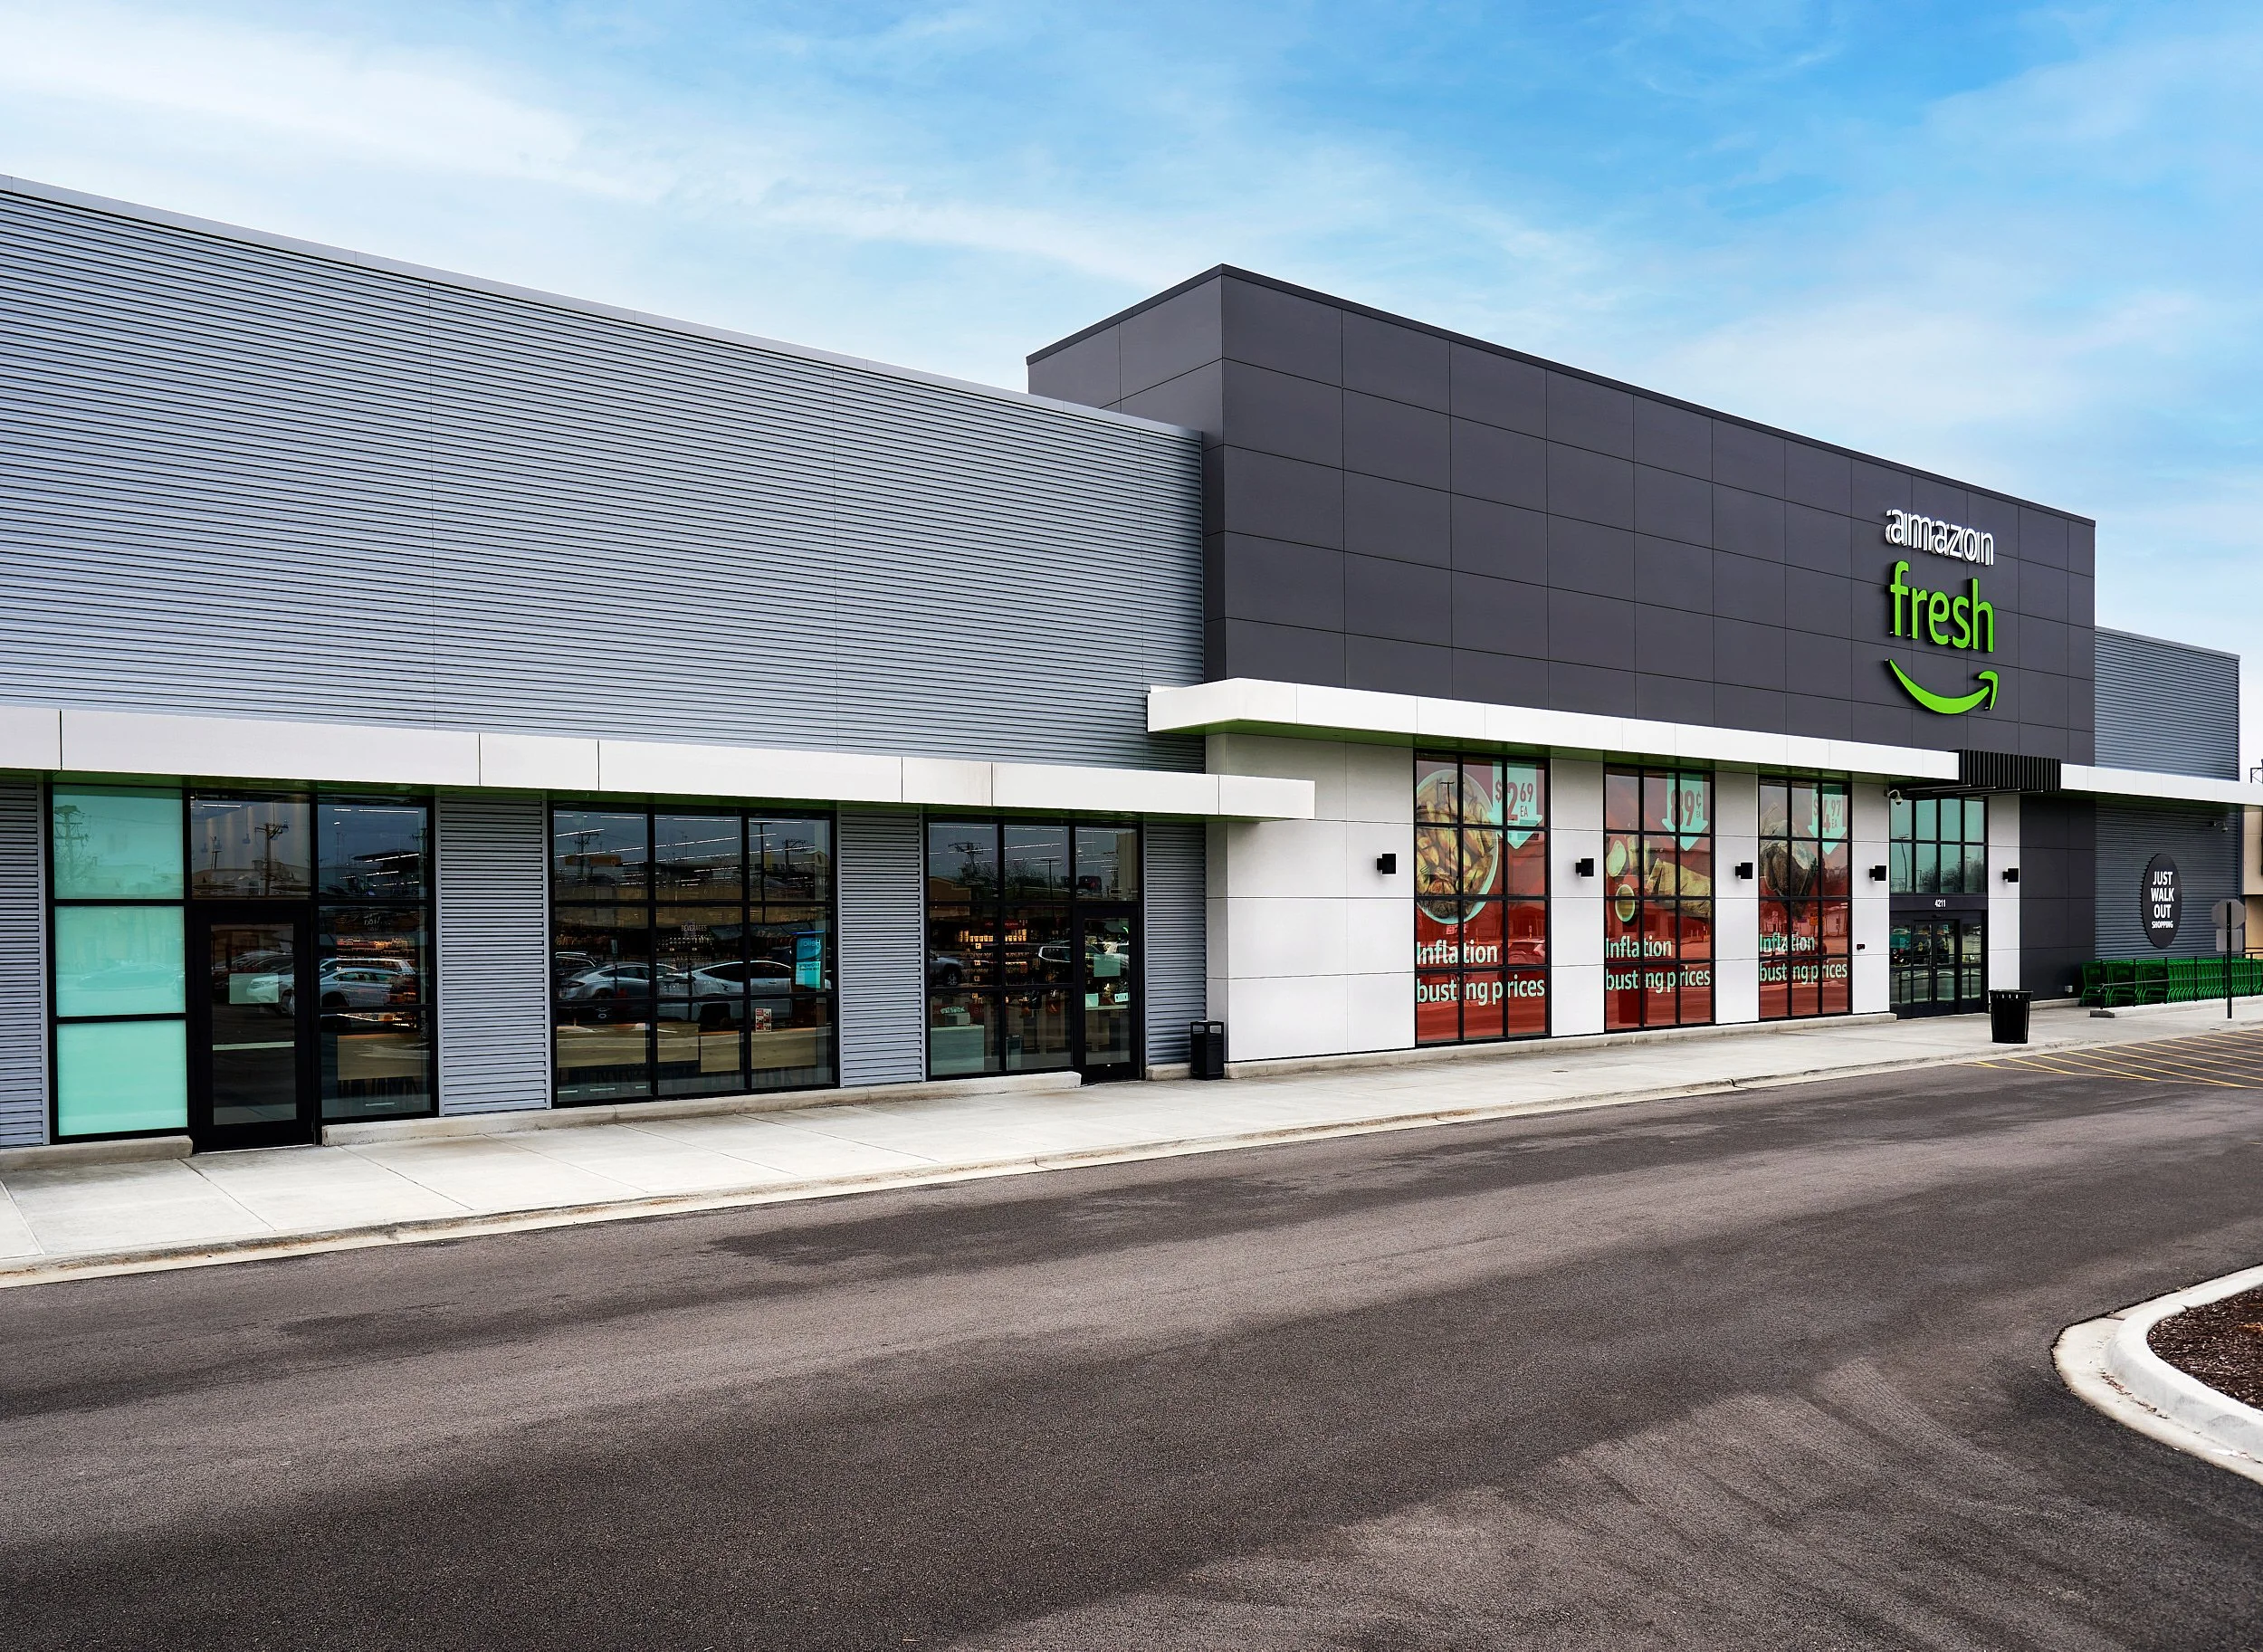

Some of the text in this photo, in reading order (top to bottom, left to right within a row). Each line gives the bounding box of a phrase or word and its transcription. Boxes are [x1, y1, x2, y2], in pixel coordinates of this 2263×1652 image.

[1886, 509, 1993, 565] amazon
[1890, 560, 1994, 652] fresh
[1521, 806, 1528, 817] EA
[2153, 871, 2172, 885] JUST
[1934, 899, 1946, 908] 4211
[2151, 888, 2174, 902] WALK
[2153, 904, 2172, 918] OUT
[2152, 921, 2173, 929] SHOPPING
[1417, 940, 1497, 964] Inflation
[1606, 935, 1672, 958] Inflation
[1759, 931, 1815, 952] Inflation
[1667, 964, 1711, 992] prices
[1759, 960, 1848, 985] bustng prices
[1492, 974, 1545, 1005] prices
